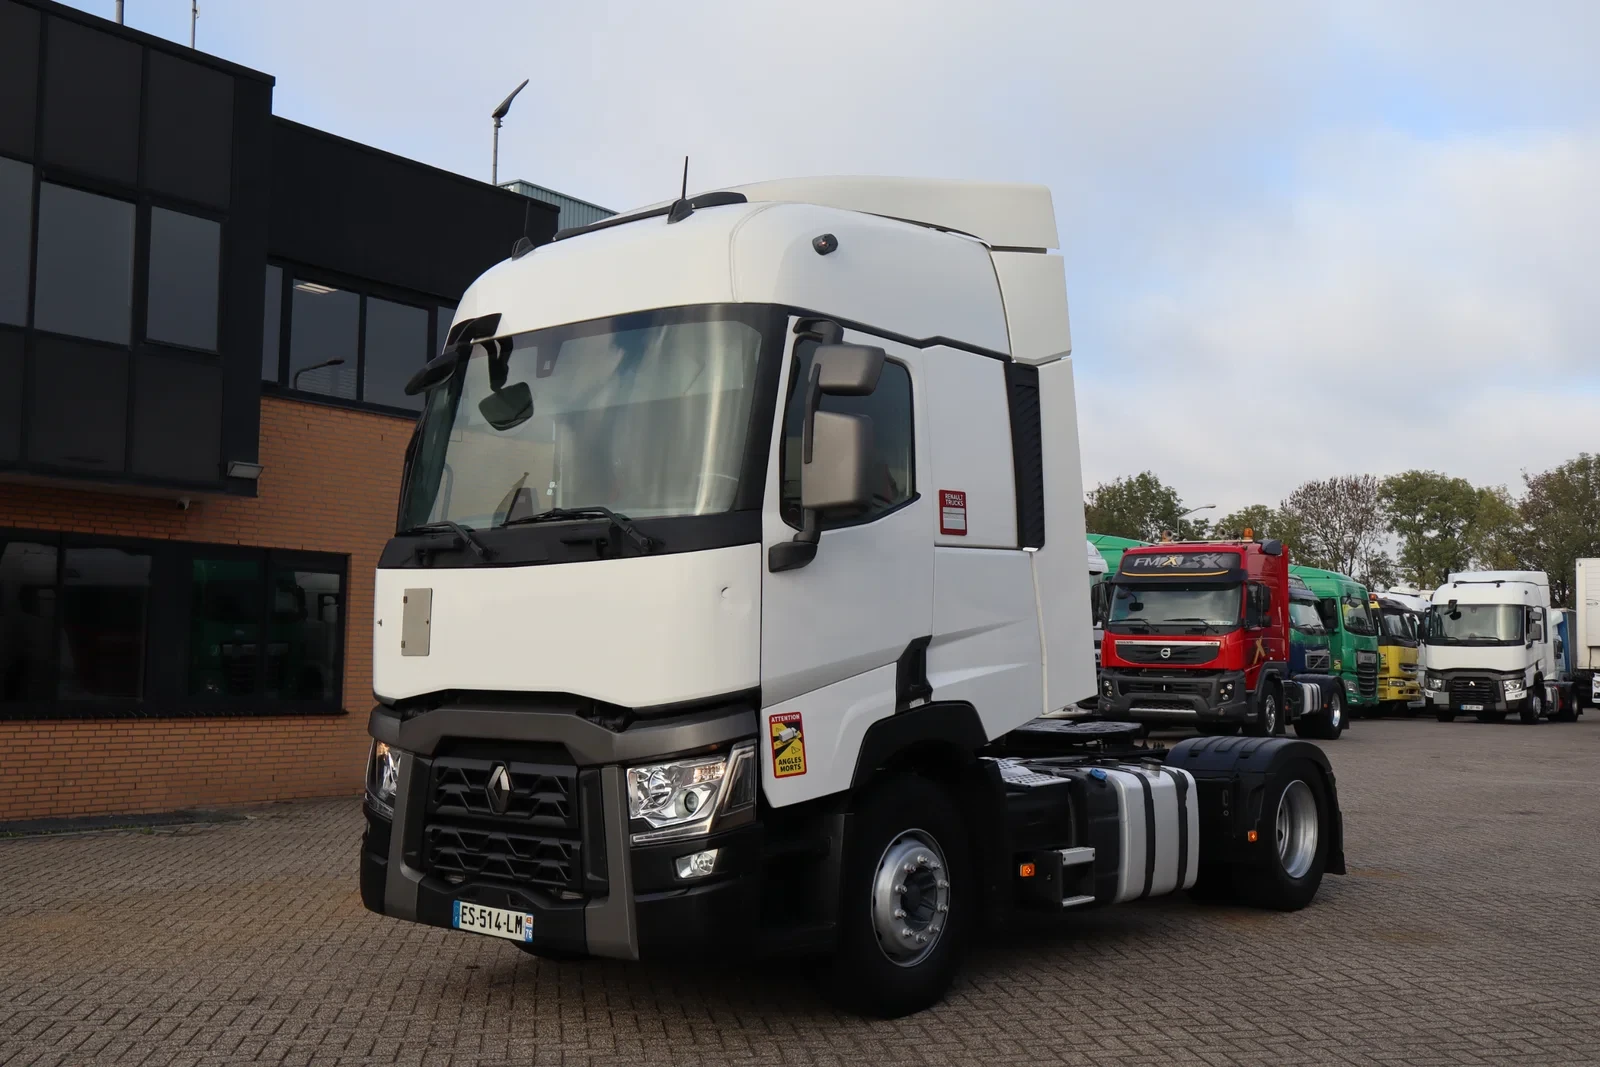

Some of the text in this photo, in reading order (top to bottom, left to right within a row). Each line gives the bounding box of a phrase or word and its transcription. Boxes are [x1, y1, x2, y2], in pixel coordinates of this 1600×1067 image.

[1133, 555, 1184, 567] FMX
[771, 714, 800, 723] ATTENTION
[778, 757, 802, 765] ANGLES
[780, 764, 802, 772] MORTS
[526, 929, 533, 939] 76
